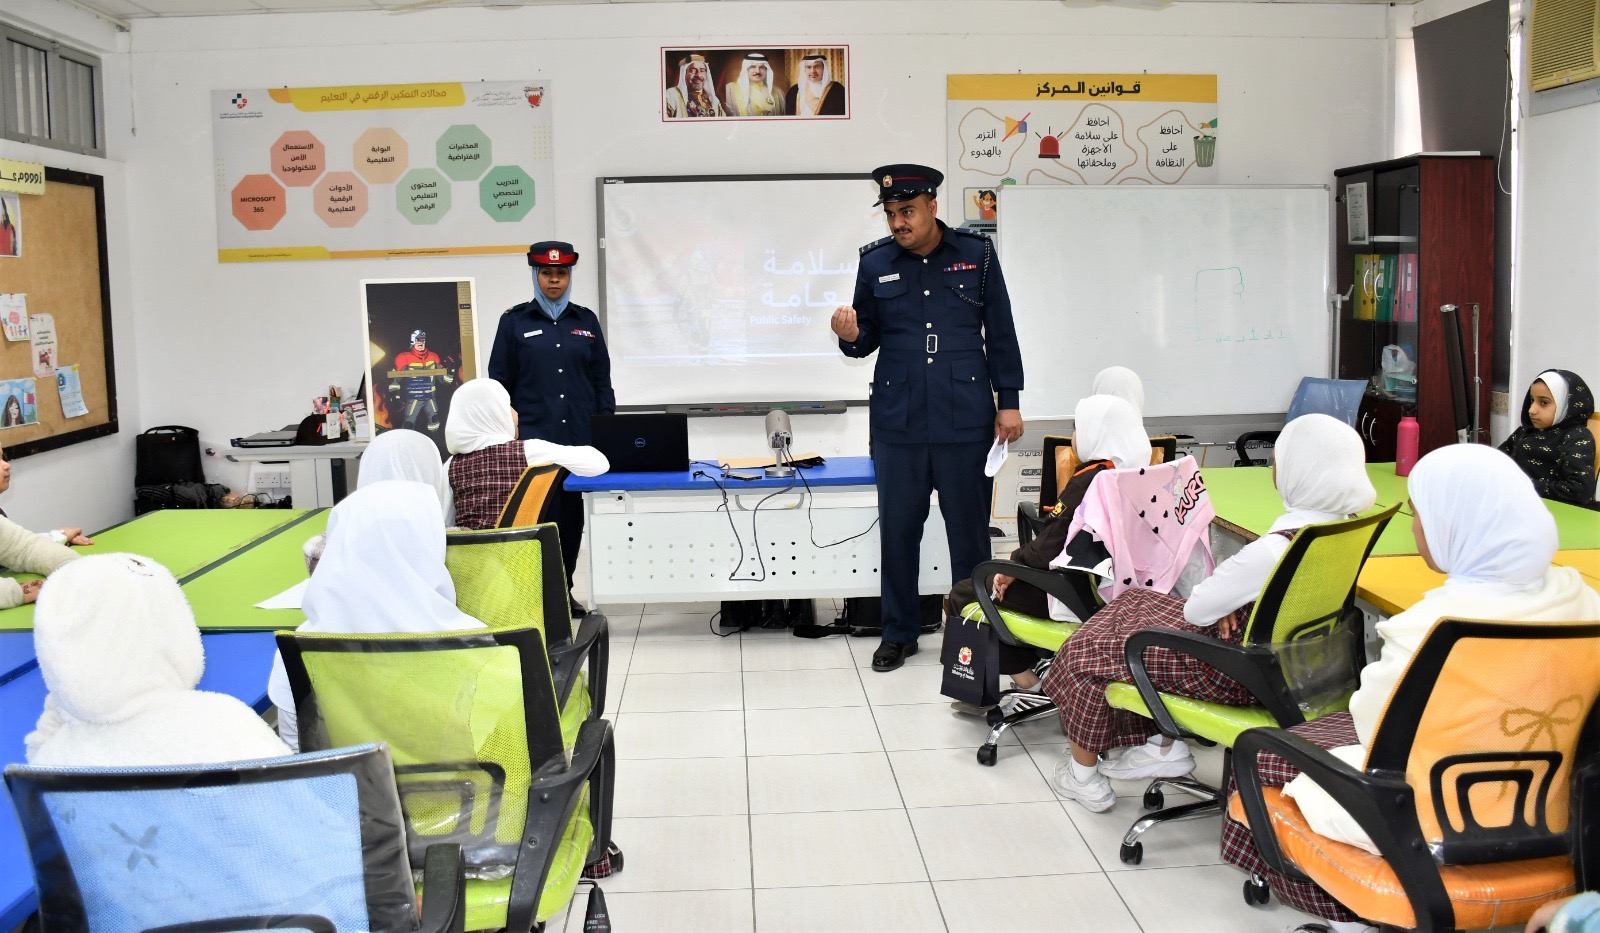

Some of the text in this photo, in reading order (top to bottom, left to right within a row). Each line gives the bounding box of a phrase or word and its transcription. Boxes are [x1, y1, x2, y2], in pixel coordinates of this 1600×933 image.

[1036, 81, 1141, 97] قوانين المركز
[320, 89, 447, 104] مجالات التمكين الرقمي في التعليم
[1085, 116, 1110, 128] أحافظ
[975, 128, 996, 140] ألتزم
[1074, 129, 1119, 141] على سلامة
[1159, 125, 1183, 136] أحافظ
[282, 143, 314, 151] الاستعمال
[371, 145, 391, 153] البوابة
[448, 142, 479, 151] المختبرات
[970, 145, 1001, 158] بالهدوء
[1162, 142, 1179, 153] على
[366, 156, 395, 164] التعليمية
[447, 153, 480, 161] الافتراضية
[1077, 158, 1117, 169] وملحقاتها
[1155, 157, 1185, 169] النظافة
[281, 164, 317, 173] للتكنولوجيا
[410, 181, 437, 191] المحتوى
[496, 179, 519, 187] التدريب
[410, 192, 438, 202] التعليمي
[492, 189, 523, 199] التخصصي
[329, 195, 353, 204] الرقمية
[497, 200, 519, 209] النوعي
[327, 205, 356, 213] التعليمية
[413, 203, 436, 213] الرقمي
[763, 248, 859, 276] سلامة
[761, 280, 853, 308] عامة
[750, 313, 812, 326] Public Safety
